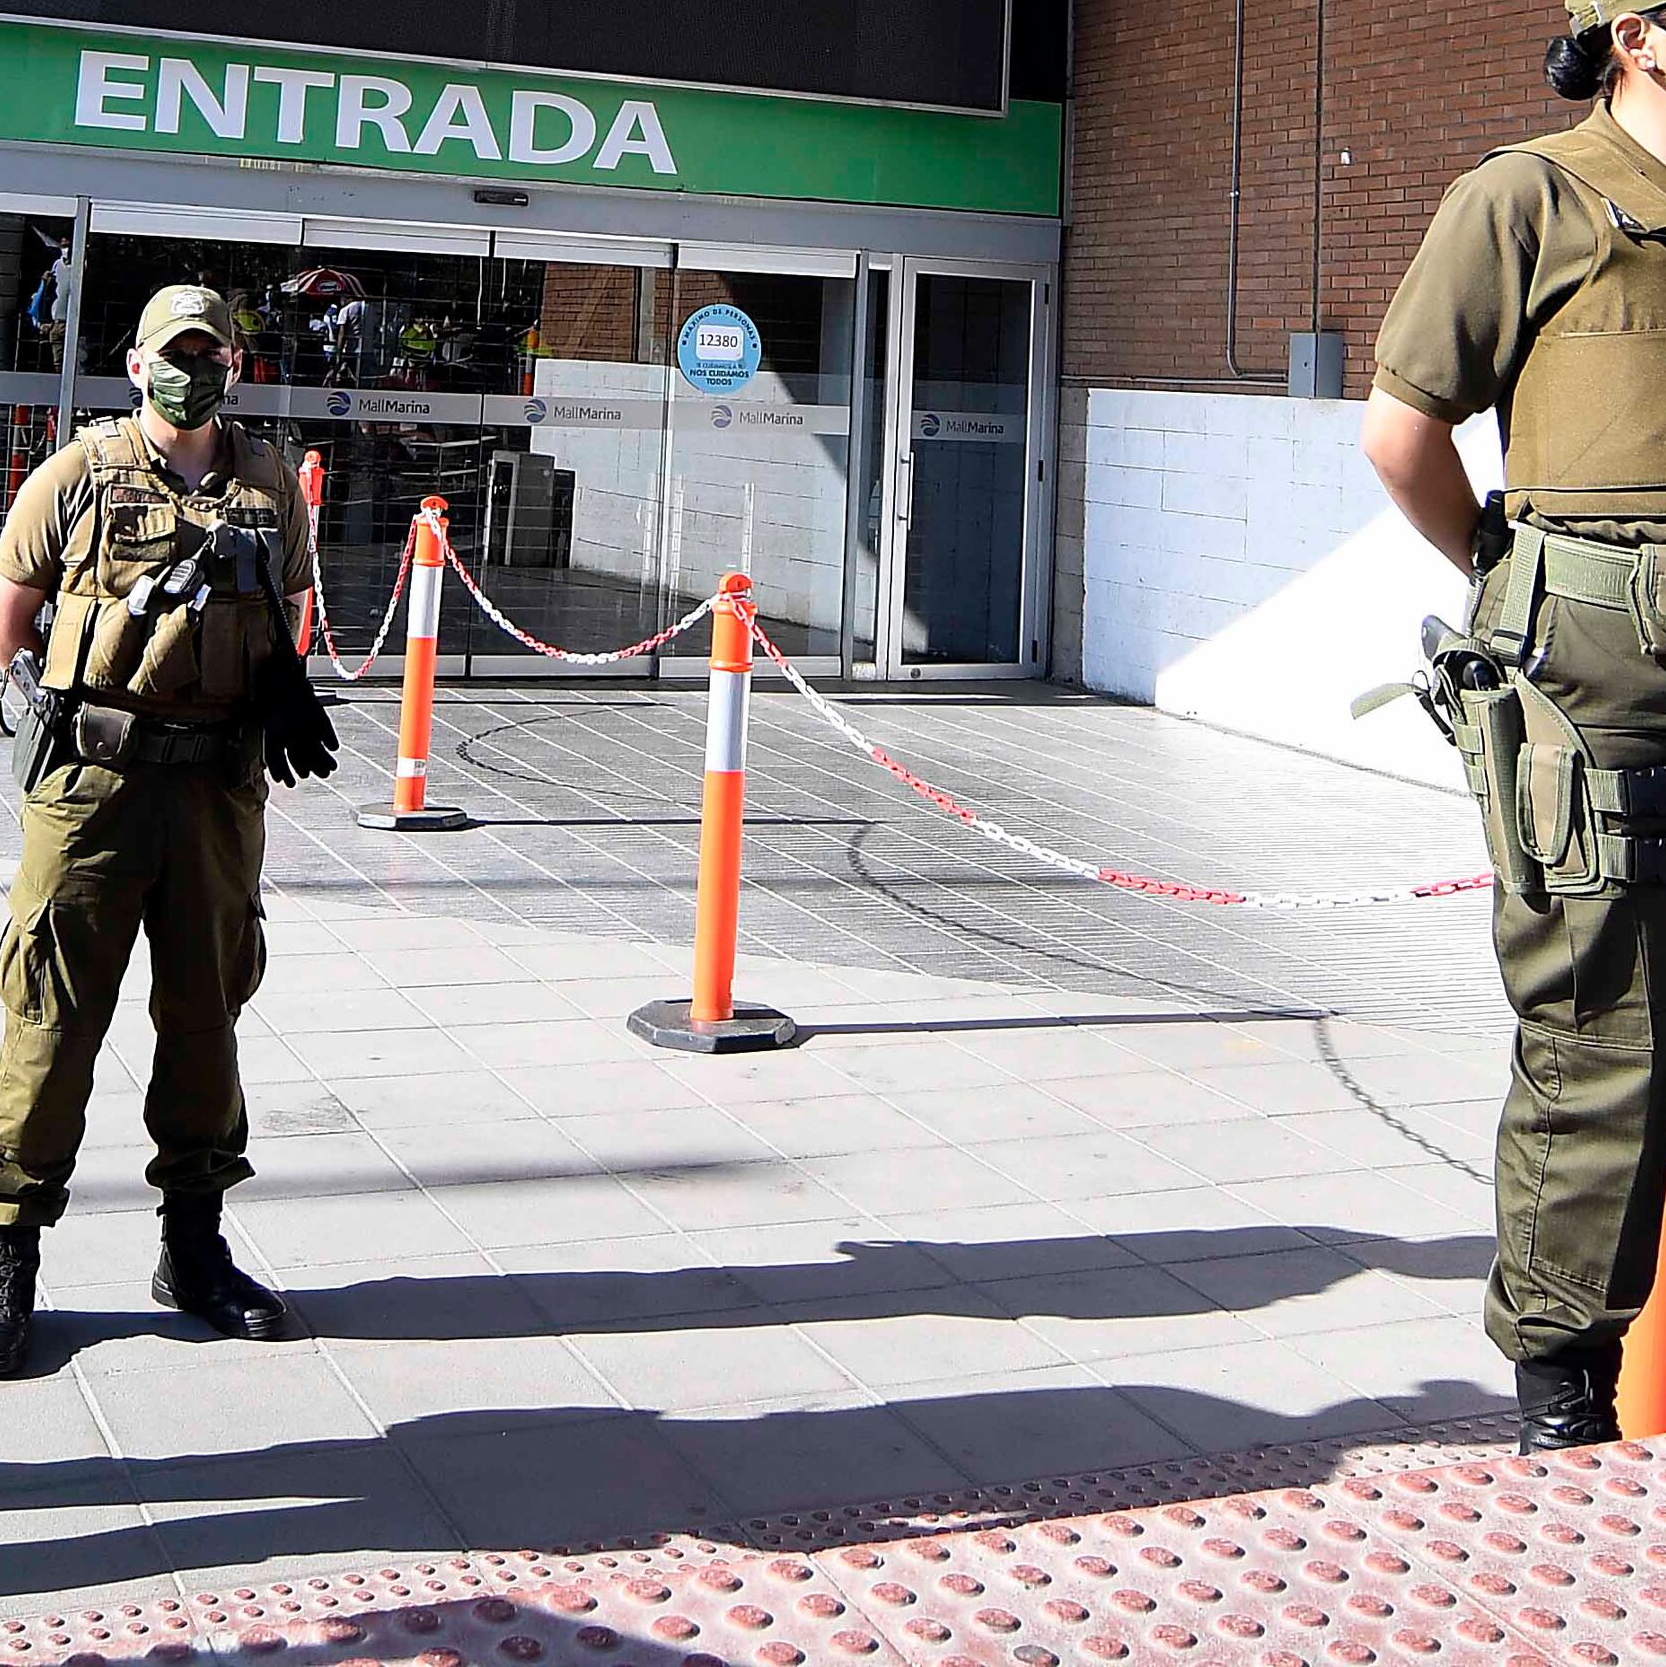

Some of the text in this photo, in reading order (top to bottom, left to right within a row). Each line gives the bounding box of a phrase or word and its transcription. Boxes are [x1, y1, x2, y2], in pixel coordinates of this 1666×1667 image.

[74, 49, 679, 175] ENTRADA
[725, 309, 756, 340] PERSONAS
[699, 334, 738, 348] 12380
[689, 369, 750, 379] NOS CUIDAMOS
[706, 378, 732, 386] TODOS
[359, 398, 430, 415] MallMarina
[554, 405, 622, 420] MallMarina
[739, 411, 804, 425] MallMarina
[946, 420, 1005, 434] MallMarina
